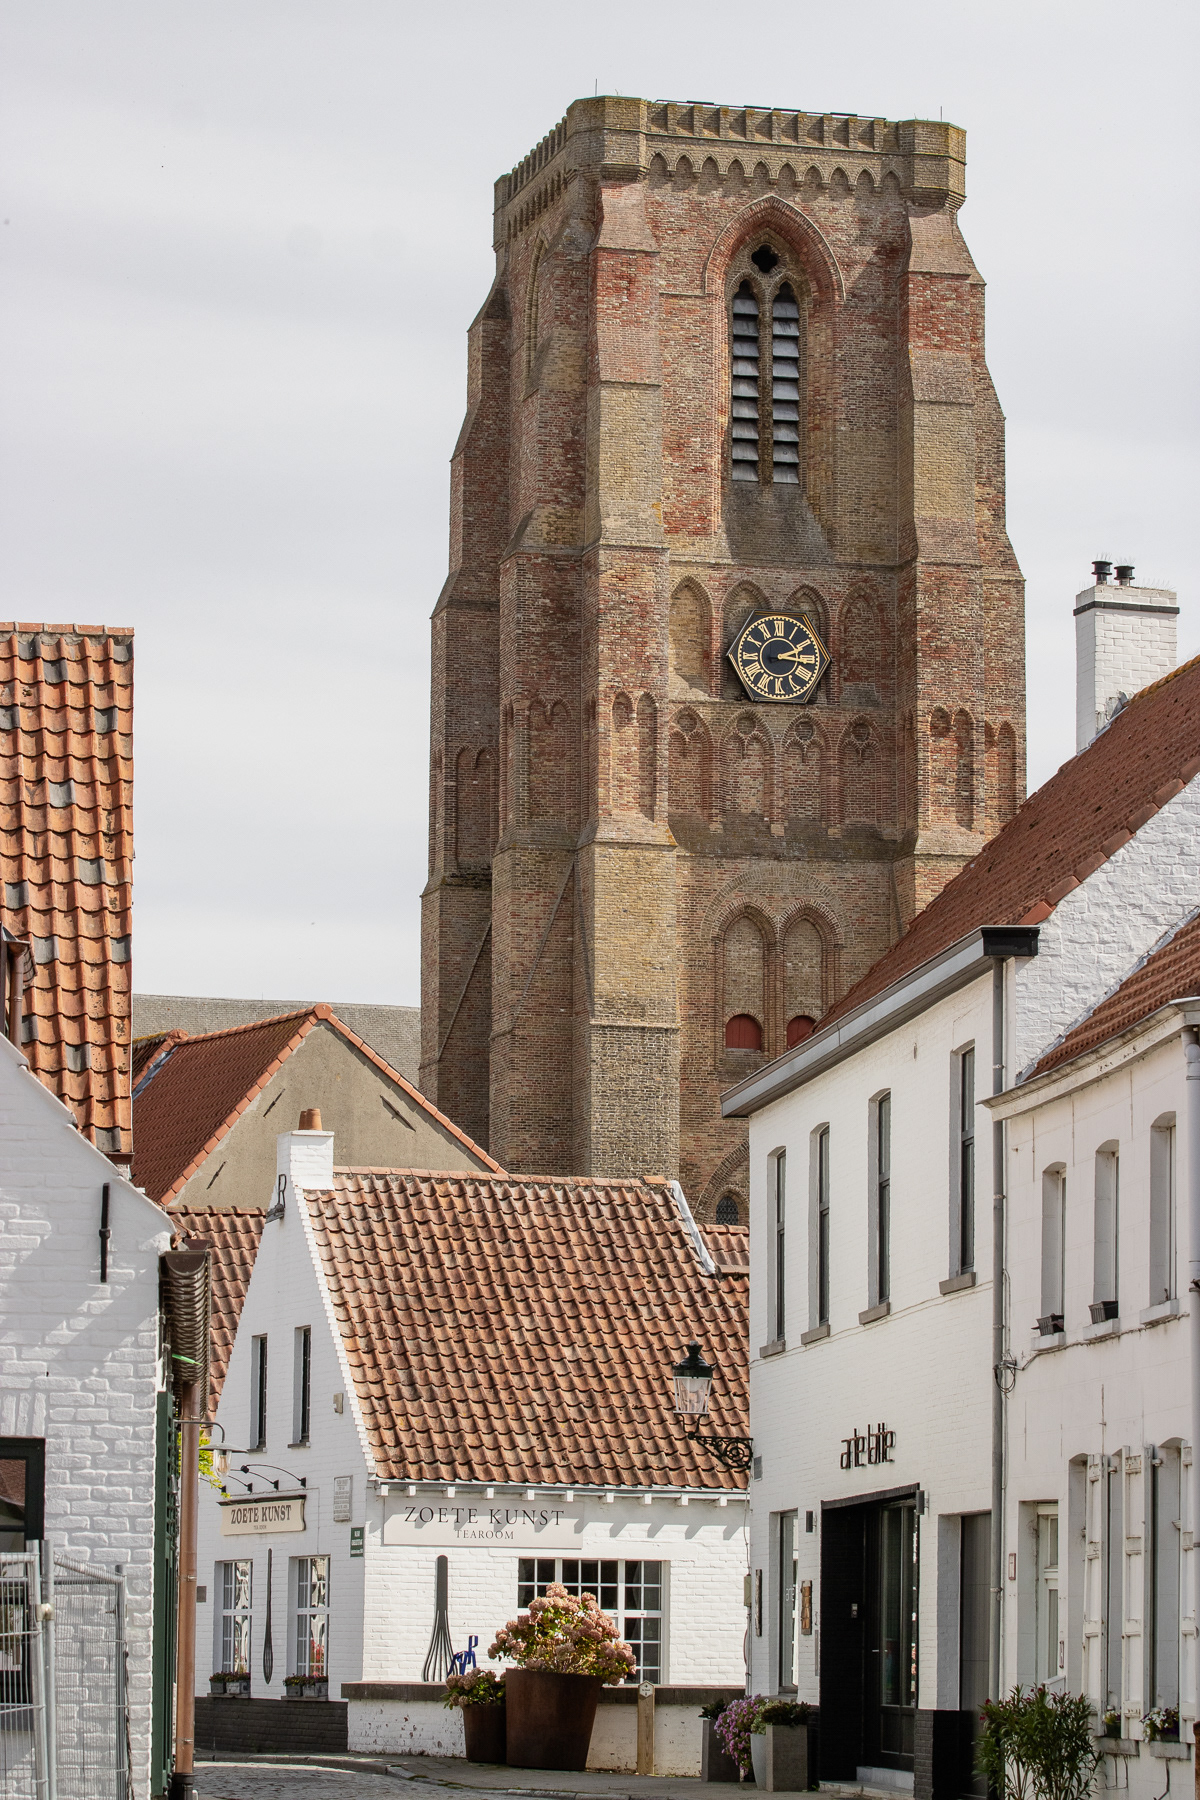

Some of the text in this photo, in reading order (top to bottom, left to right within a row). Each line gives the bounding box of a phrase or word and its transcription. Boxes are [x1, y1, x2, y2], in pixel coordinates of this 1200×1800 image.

[758, 623, 771, 640] XI
[774, 620, 784, 637] XII
[788, 626, 798, 640] I
[747, 635, 762, 648] X
[796, 639, 811, 649] II
[742, 651, 758, 660] IX
[744, 661, 764, 681] VIII
[795, 665, 812, 681] IIII
[757, 673, 773, 692] VII
[775, 677, 785, 694] VI
[788, 675, 801, 691] V
[231, 1504, 292, 1524] ZOETE KUNST
[404, 1506, 564, 1526] ZOETE KUNST
[454, 1529, 514, 1540] TEAROOM
